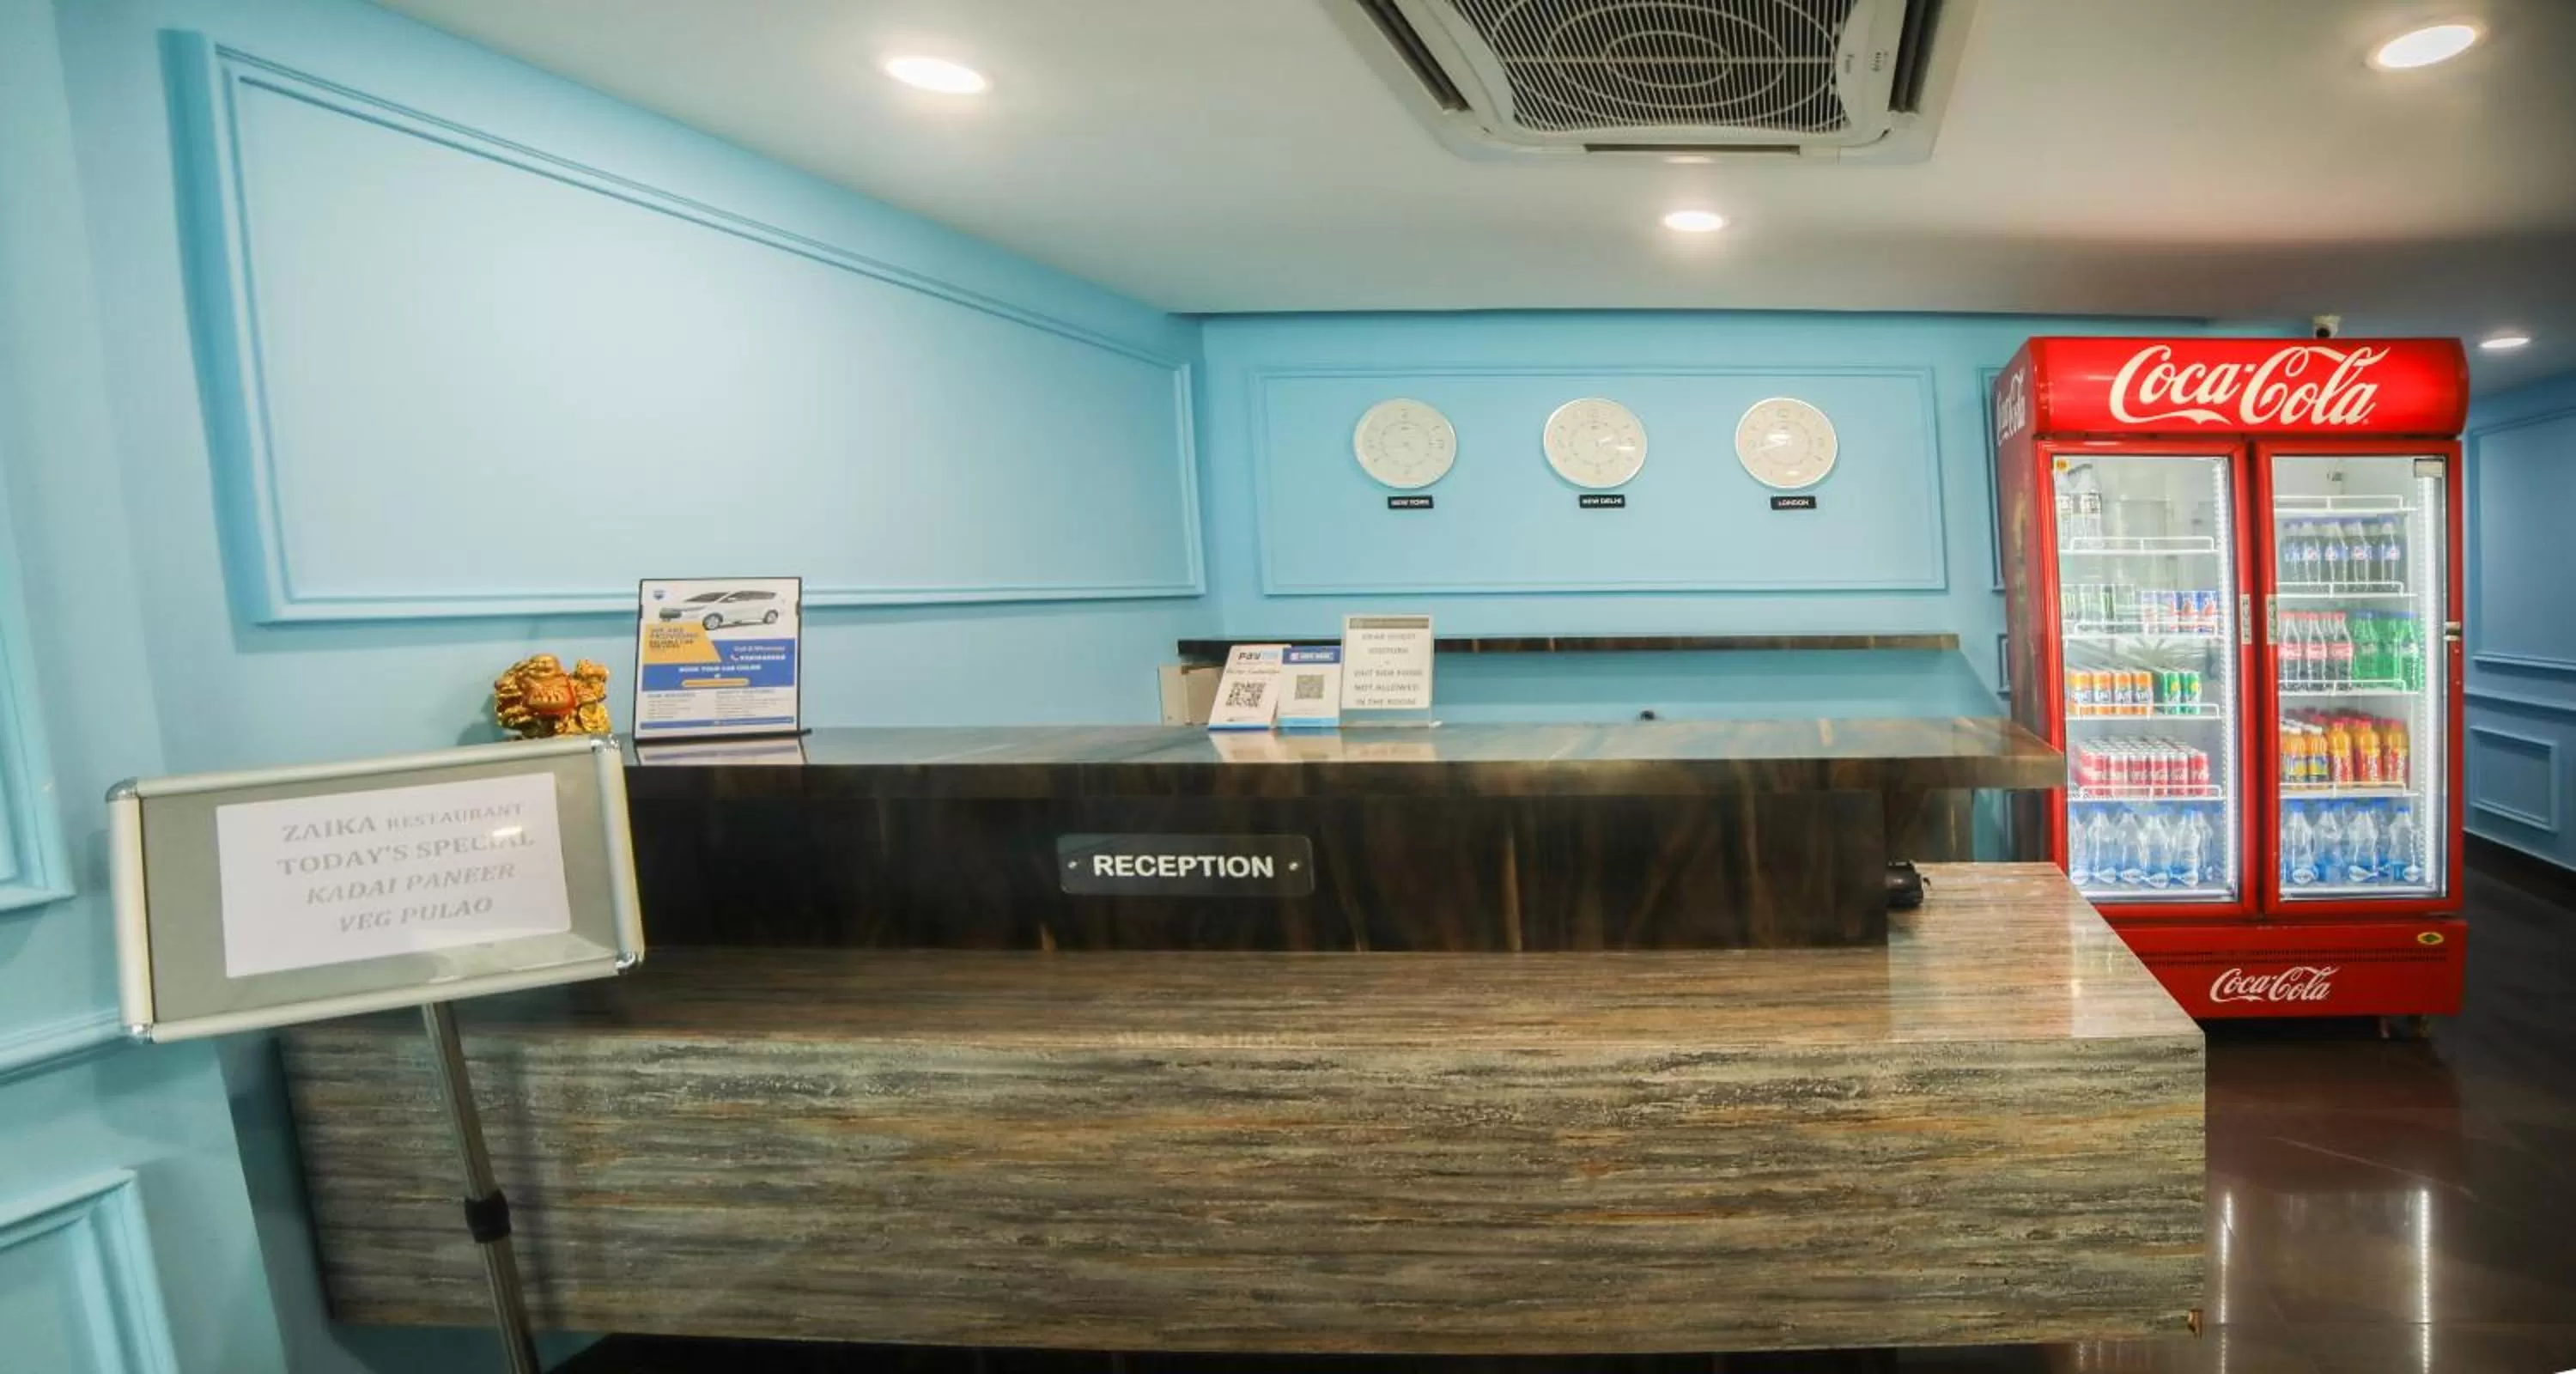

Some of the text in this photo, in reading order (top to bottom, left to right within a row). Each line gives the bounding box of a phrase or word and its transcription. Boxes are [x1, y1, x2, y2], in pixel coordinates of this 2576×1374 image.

[2109, 344, 2390, 425] Coca-Cola
[282, 802, 524, 843] ZAIKA RESTAURANT
[276, 843, 409, 876] TODAY'S
[1093, 854, 1274, 878] RECEPTION
[306, 861, 515, 905] KADAI PANEER
[338, 896, 494, 933] VEG PULAO
[2209, 966, 2340, 1003] Coca-Cola
